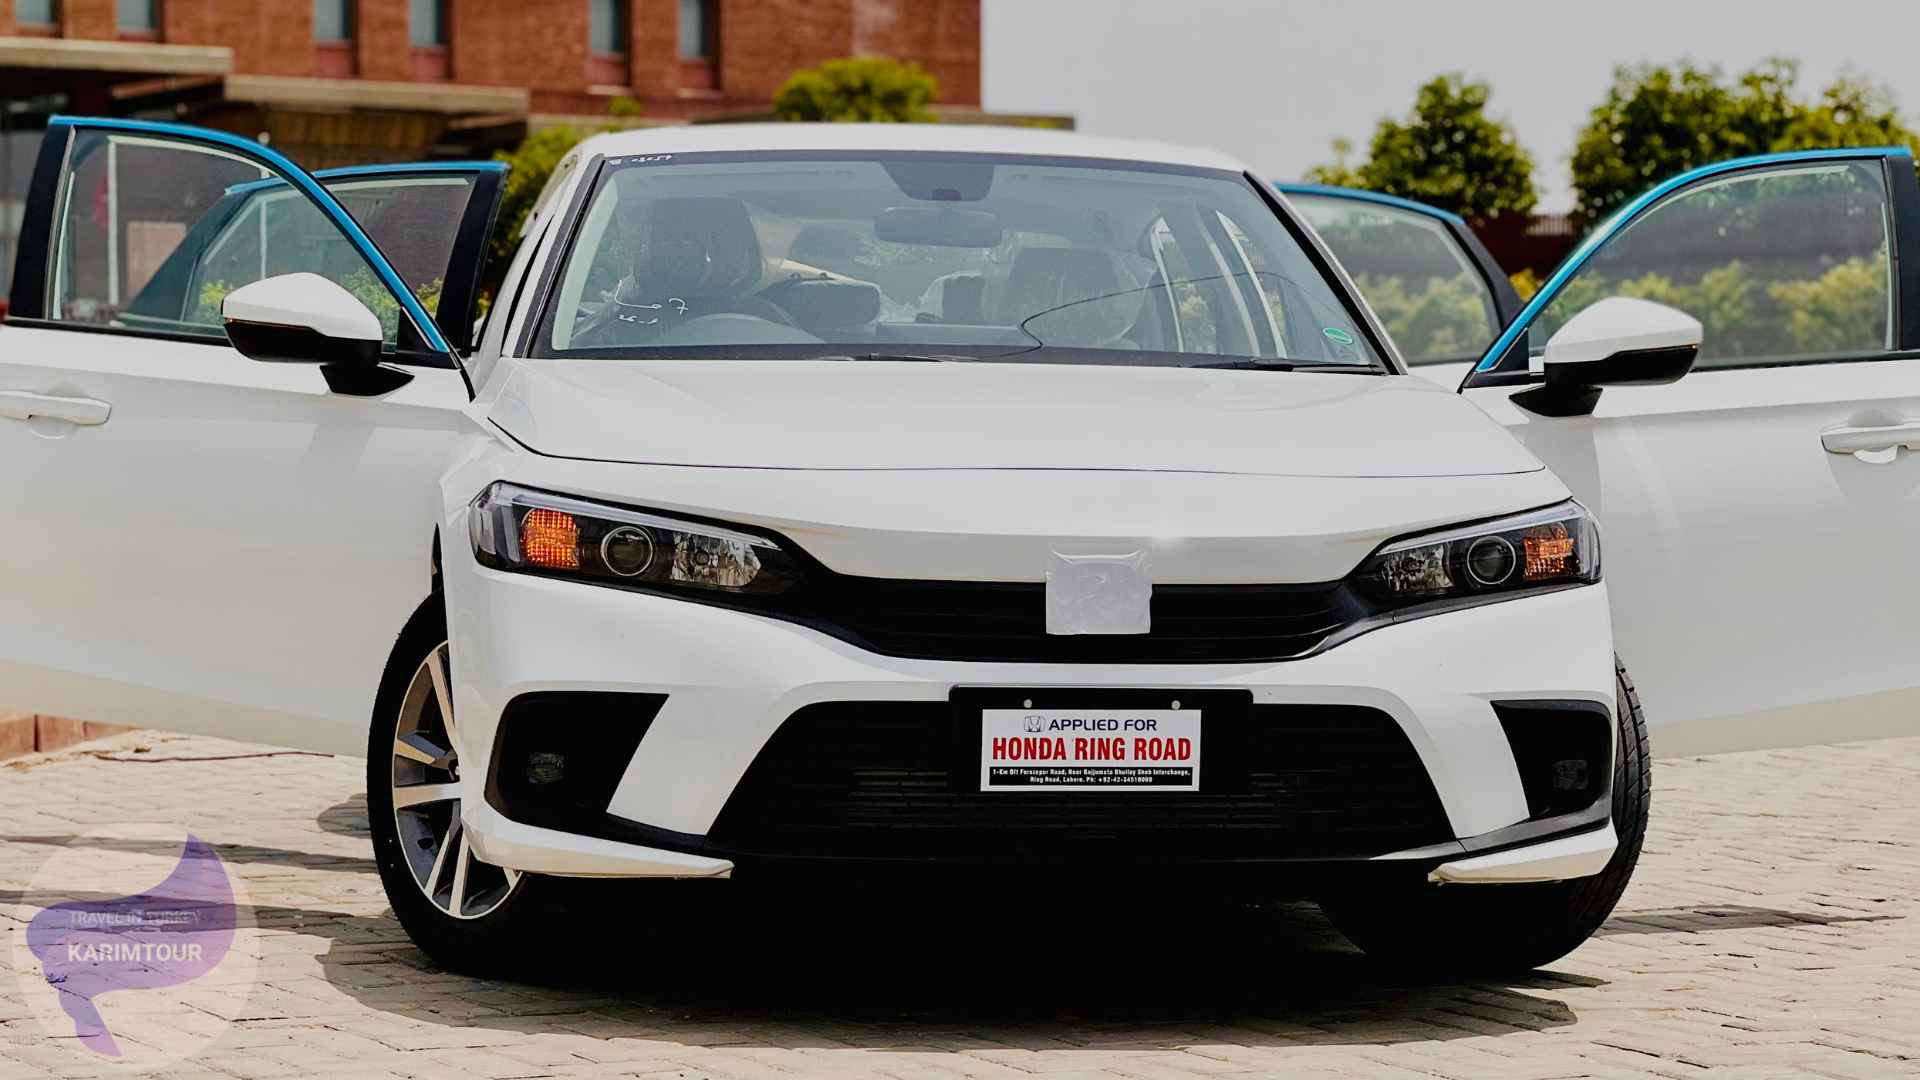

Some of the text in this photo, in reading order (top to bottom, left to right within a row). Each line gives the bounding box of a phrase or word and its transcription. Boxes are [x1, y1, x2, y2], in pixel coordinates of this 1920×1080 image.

[1048, 719, 1157, 731] APPLIED FOR
[992, 737, 1191, 761] HONDA RING ROAD
